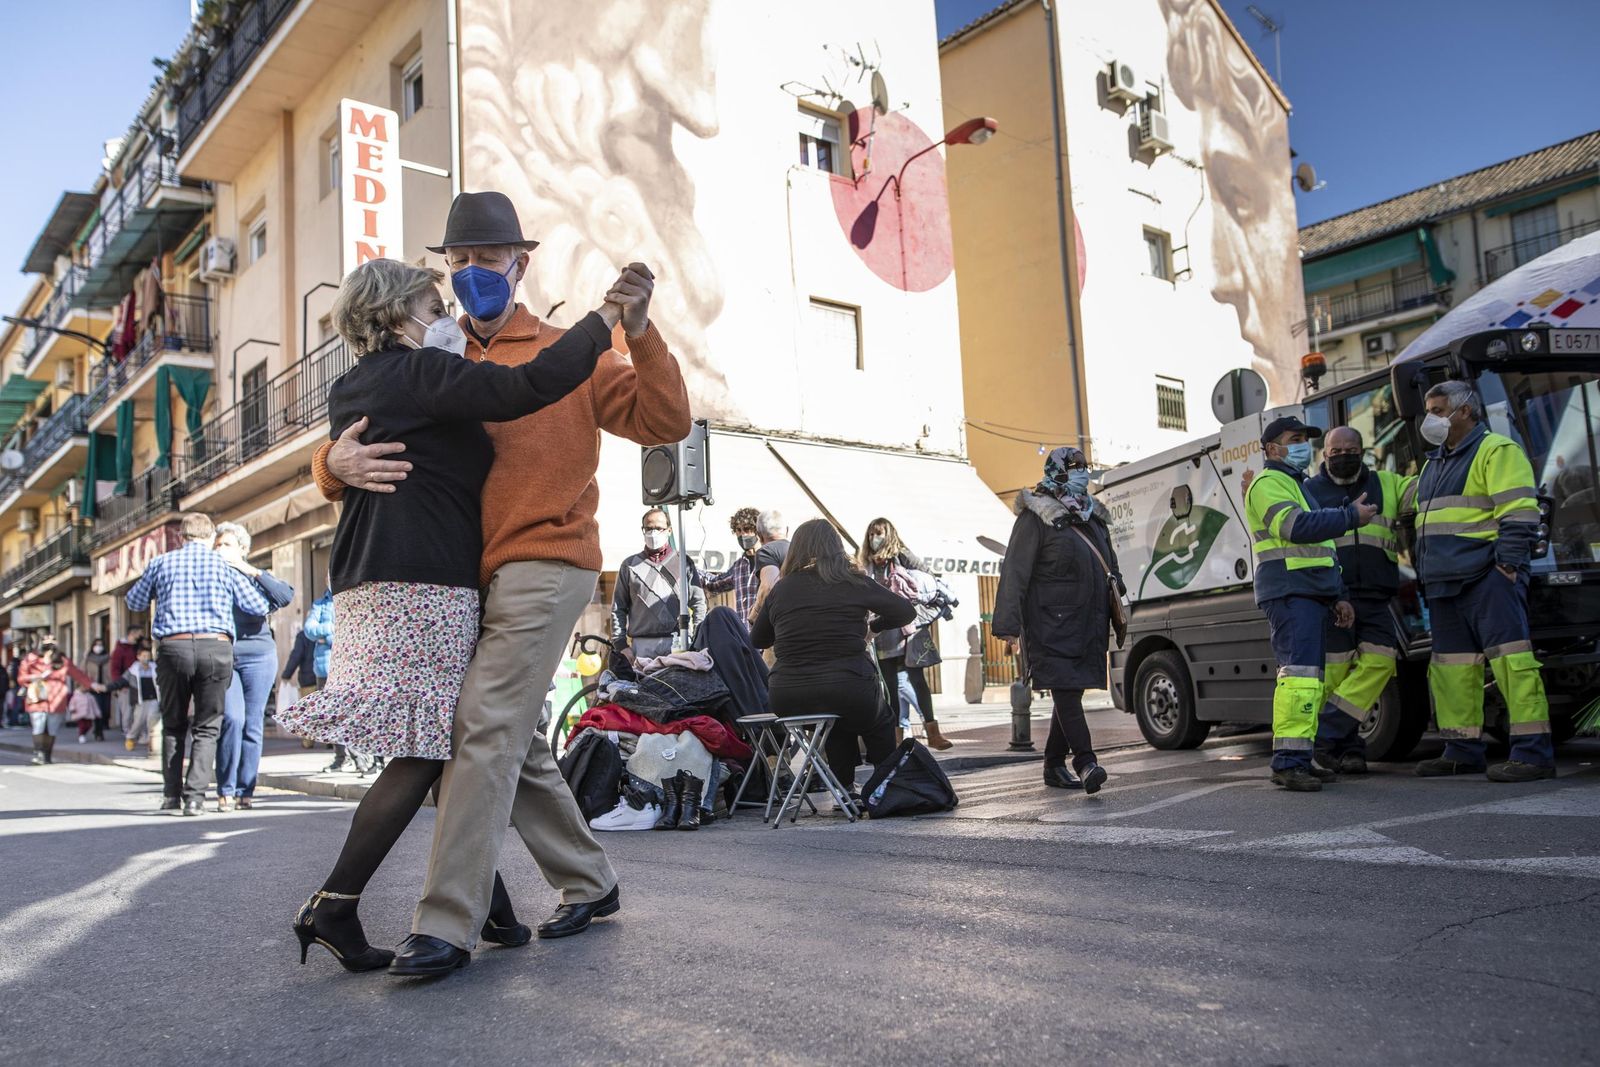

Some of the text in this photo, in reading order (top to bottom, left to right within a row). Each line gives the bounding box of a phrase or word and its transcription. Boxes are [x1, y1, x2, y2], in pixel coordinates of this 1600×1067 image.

[348, 107, 389, 268] MEDIN
[1555, 334, 1562, 349] E
[1221, 439, 1261, 465] inagra
[1111, 501, 1133, 520] 00%
[923, 557, 1004, 574] ECORACI
